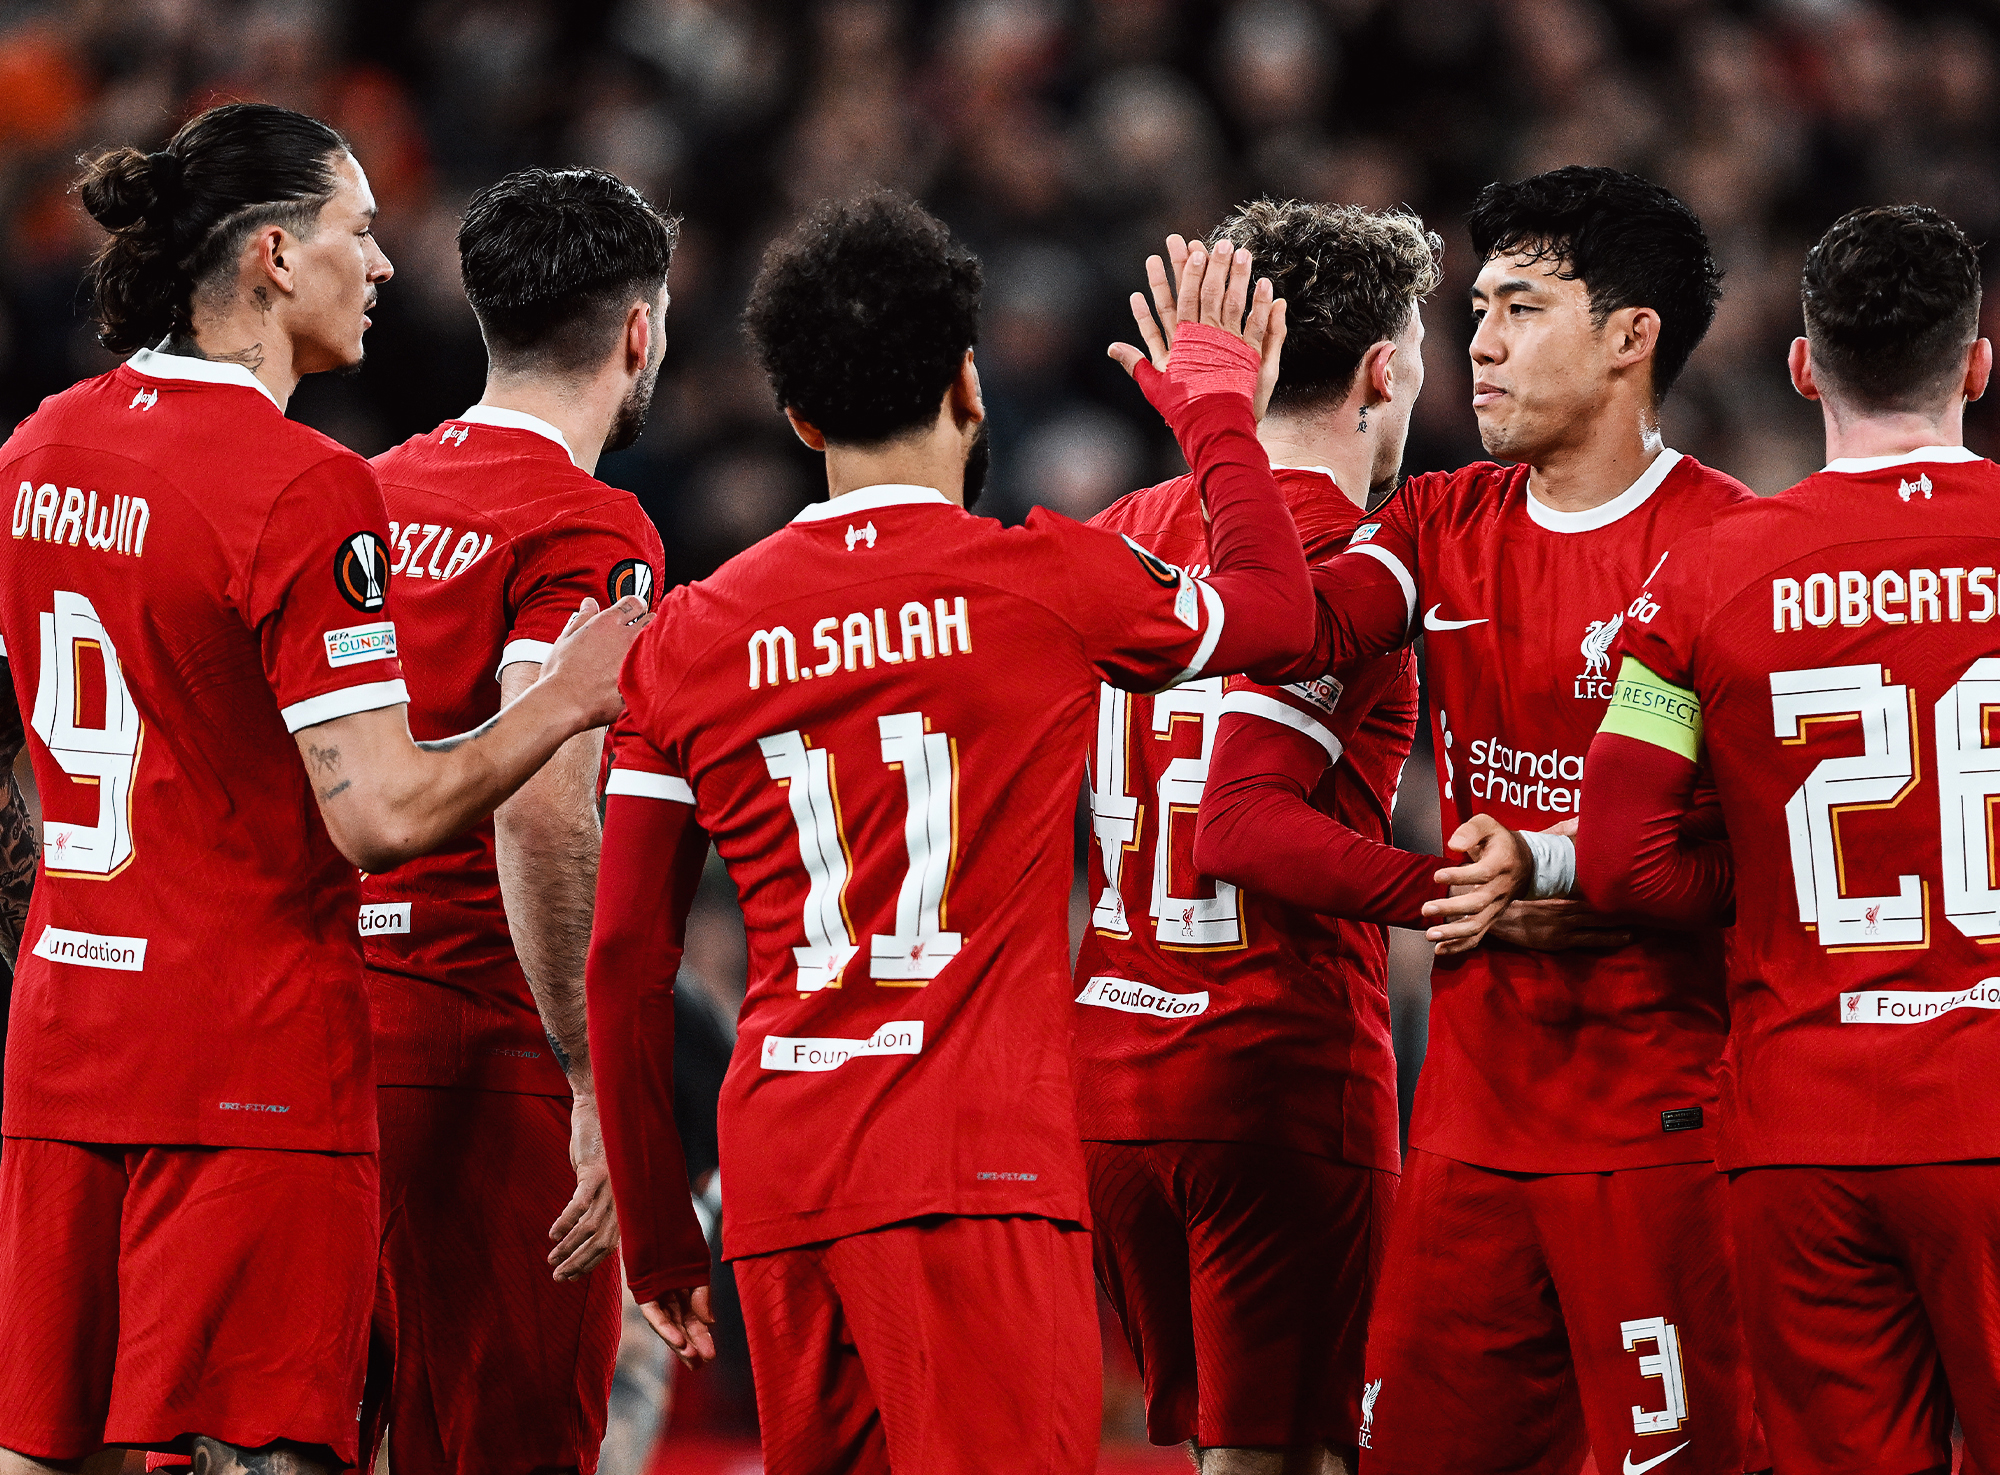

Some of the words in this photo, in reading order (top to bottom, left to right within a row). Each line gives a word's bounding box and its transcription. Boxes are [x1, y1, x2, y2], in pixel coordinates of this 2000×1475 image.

[11, 481, 150, 558] DARWIN
[1909, 480, 1921, 493] 97
[1773, 566, 2000, 633] ROBERTS
[328, 631, 349, 642] UEFA
[748, 596, 972, 690] M.SALAH
[30, 590, 144, 881] 9
[1622, 686, 1699, 723] RESPECT
[1468, 736, 1584, 781] standa
[757, 711, 970, 999] 11
[359, 909, 401, 931] tion
[1620, 1316, 1689, 1437] 3
